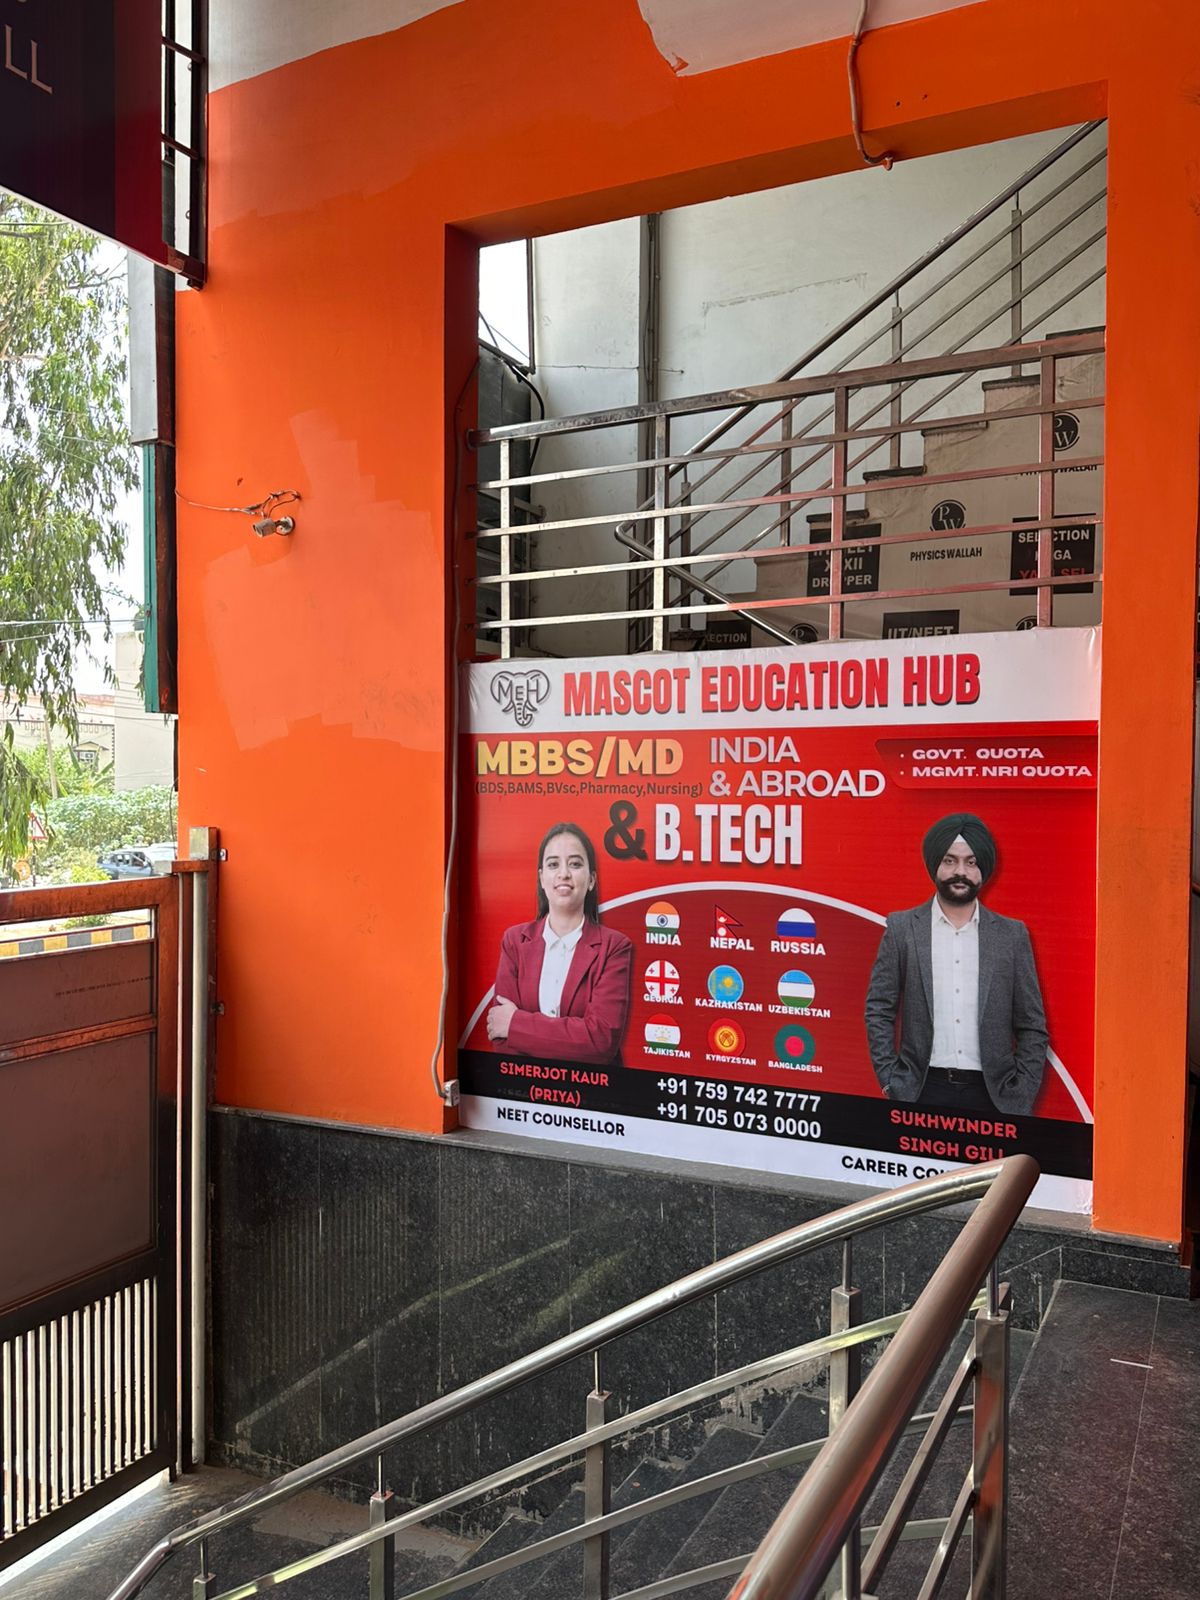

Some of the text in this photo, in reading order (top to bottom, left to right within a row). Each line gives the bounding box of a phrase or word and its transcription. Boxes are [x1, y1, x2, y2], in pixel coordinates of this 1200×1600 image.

[812, 574, 872, 588] DRPER
[563, 653, 981, 717] MASCOT EDUCATION HUB
[476, 736, 684, 778] MBBS/MD
[710, 735, 800, 764] INDIA
[912, 747, 1044, 760] GOVT. QUOTA
[1022, 765, 1092, 777] QUOTA
[708, 769, 886, 798] & ABROAD
[603, 799, 803, 866] & B.TECH
[645, 932, 682, 946] INDIA
[710, 937, 754, 951] NEPAL
[770, 940, 826, 955] RUSSIA
[643, 994, 684, 1005] GEORGIA
[695, 997, 763, 1012] KAZHAKISTAN
[768, 1004, 831, 1018] UZBEKISTAN
[643, 1046, 691, 1059] TAJIKISTAN
[705, 1053, 757, 1066] KYRGYZSTAN
[500, 1061, 609, 1086] SIMERJOT KAUR
[768, 1060, 823, 1073] BANGLADESH
[529, 1085, 581, 1107] (PRIYA)
[657, 1077, 821, 1112] +91 759 742 7777
[497, 1106, 625, 1136] NEET COUNSELLOR
[657, 1102, 822, 1139] +91 705 073 0000
[890, 1109, 1018, 1139] SUKHWINDER
[899, 1136, 959, 1157] SINGH
[841, 1155, 908, 1178] CAREER
